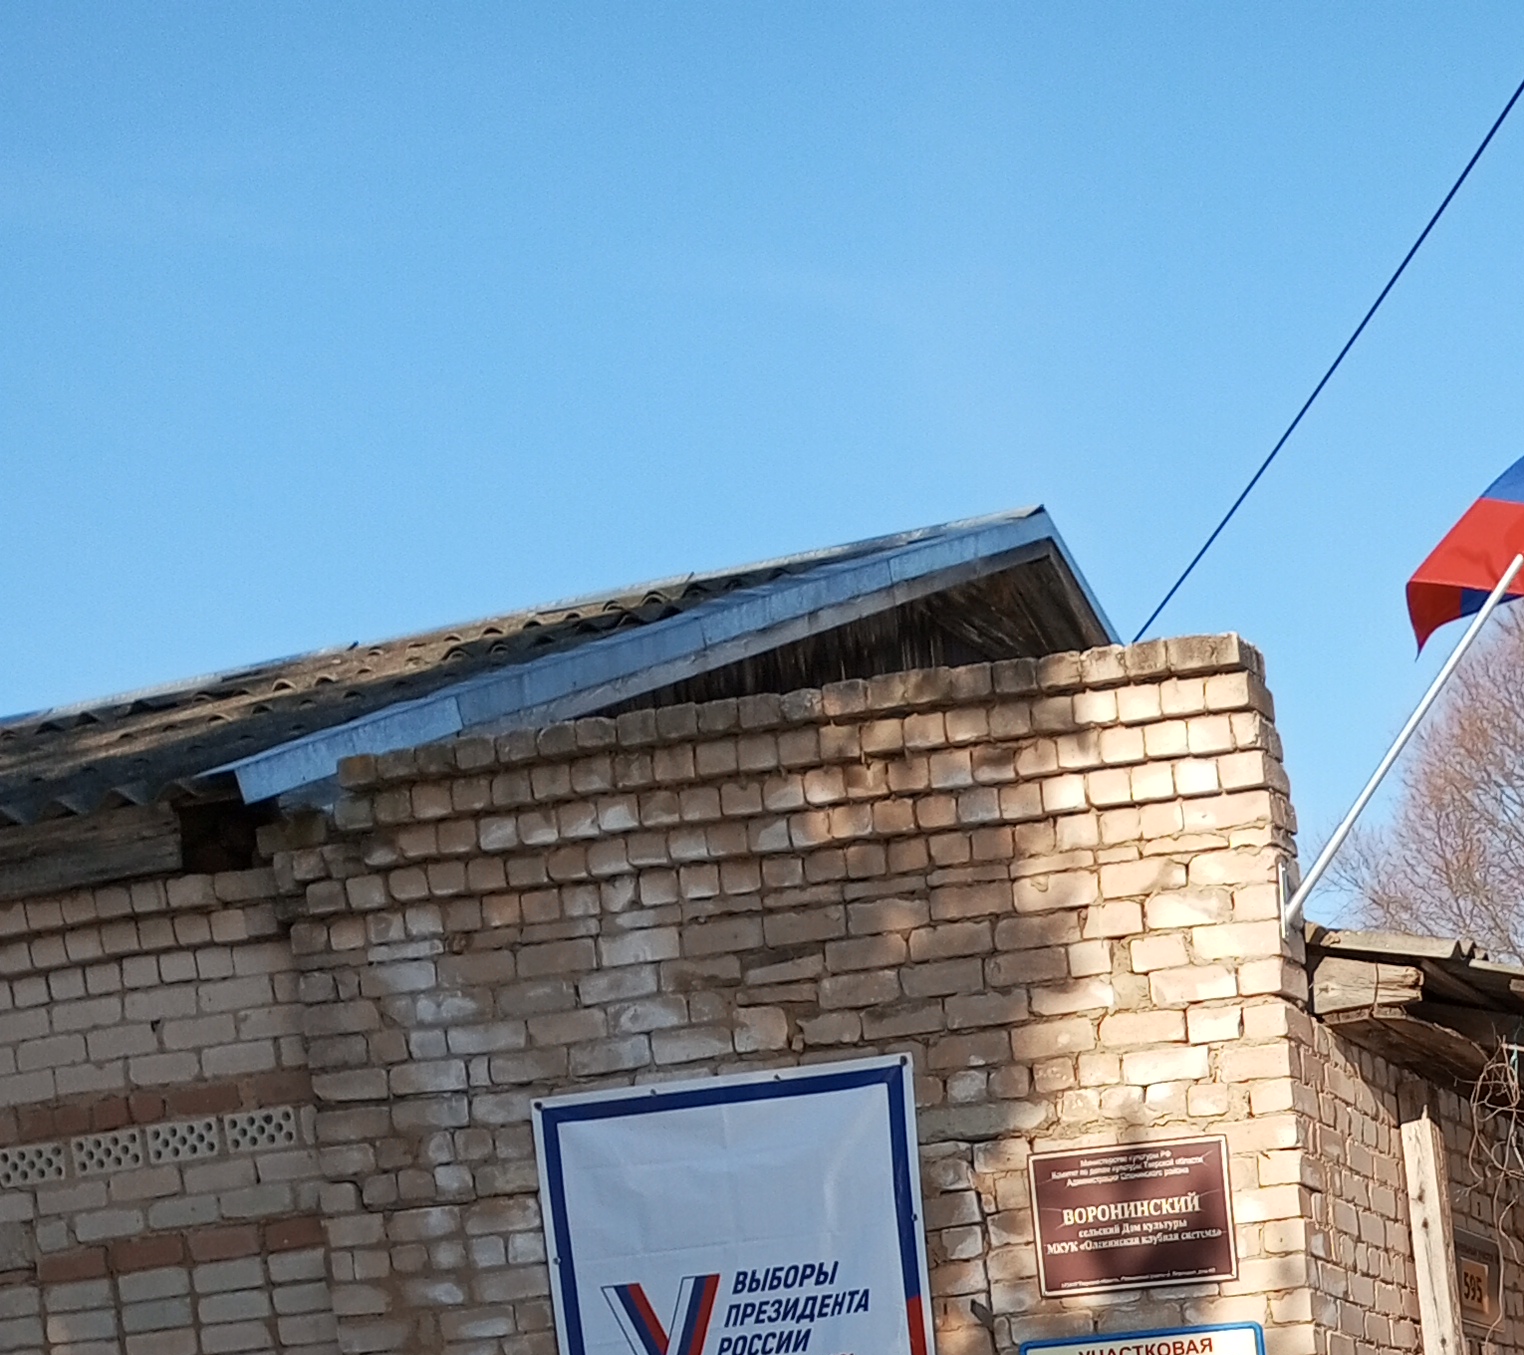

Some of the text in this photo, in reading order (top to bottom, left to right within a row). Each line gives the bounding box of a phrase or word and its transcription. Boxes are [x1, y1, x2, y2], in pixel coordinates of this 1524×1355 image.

[1062, 1191, 1201, 1226] ВОРОНИНСКИЙ
[1078, 1217, 1187, 1239] сельский Дом культуры
[1140, 1231, 1180, 1246] клубная
[1180, 1228, 1222, 1242] система»
[731, 1260, 839, 1295] ВЫБОРЫ
[1463, 1271, 1483, 1303] 595
[723, 1288, 870, 1328] ПРЕЗИДЕНТА
